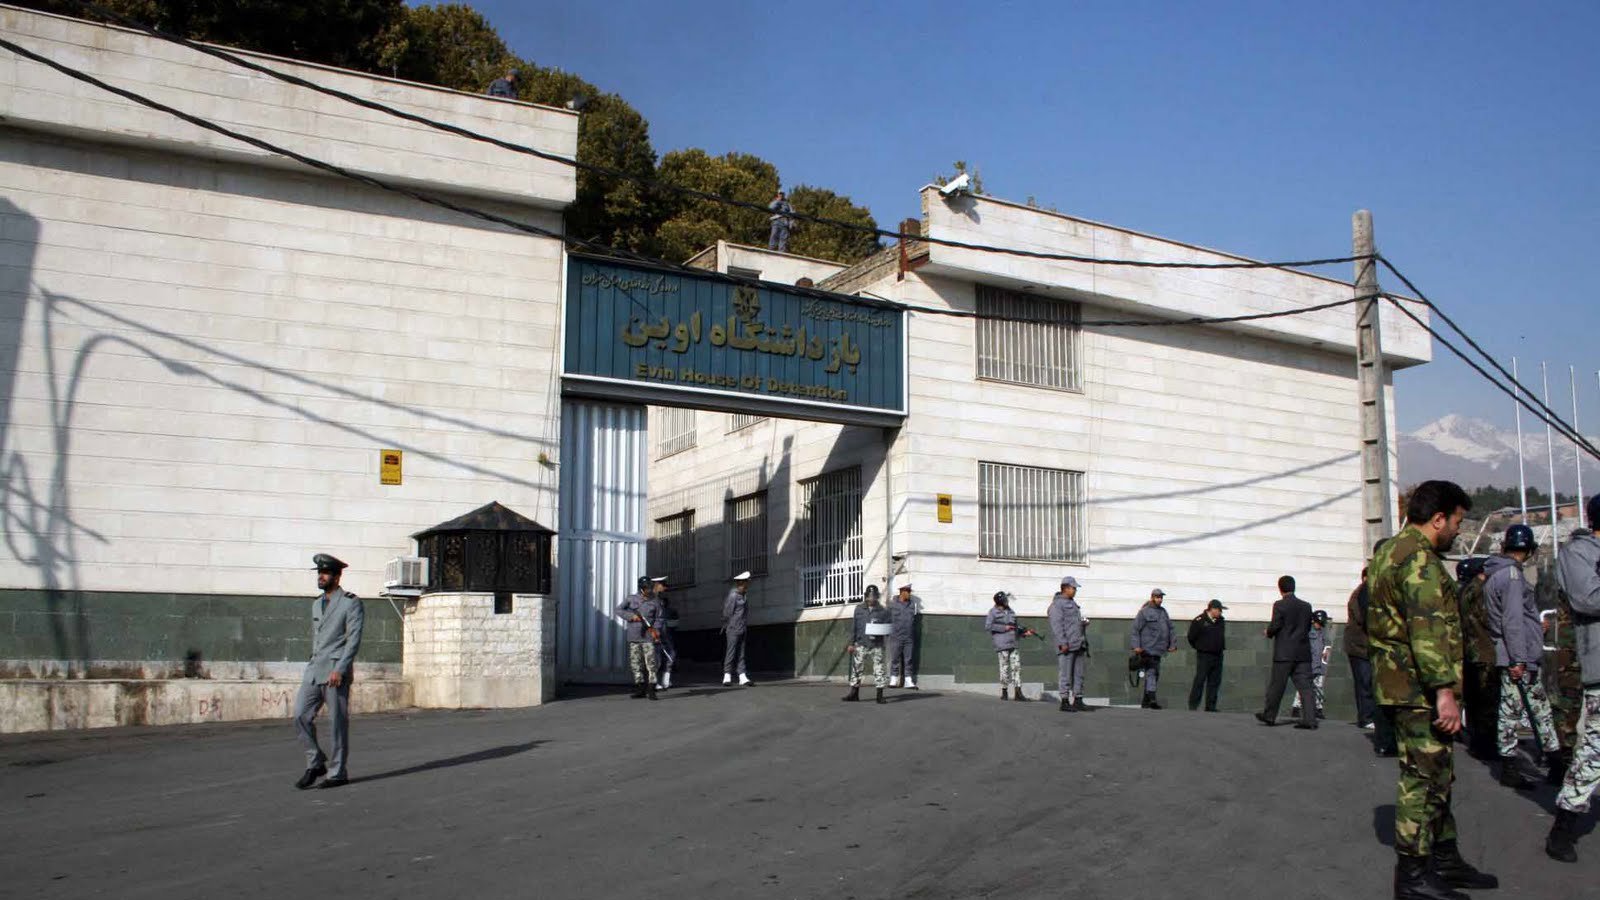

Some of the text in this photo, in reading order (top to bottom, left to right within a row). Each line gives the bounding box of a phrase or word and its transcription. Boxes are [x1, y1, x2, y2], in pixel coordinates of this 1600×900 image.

[623, 310, 861, 375] بازداشتگاه اوین
[635, 363, 849, 400] Evin House Of Detention
